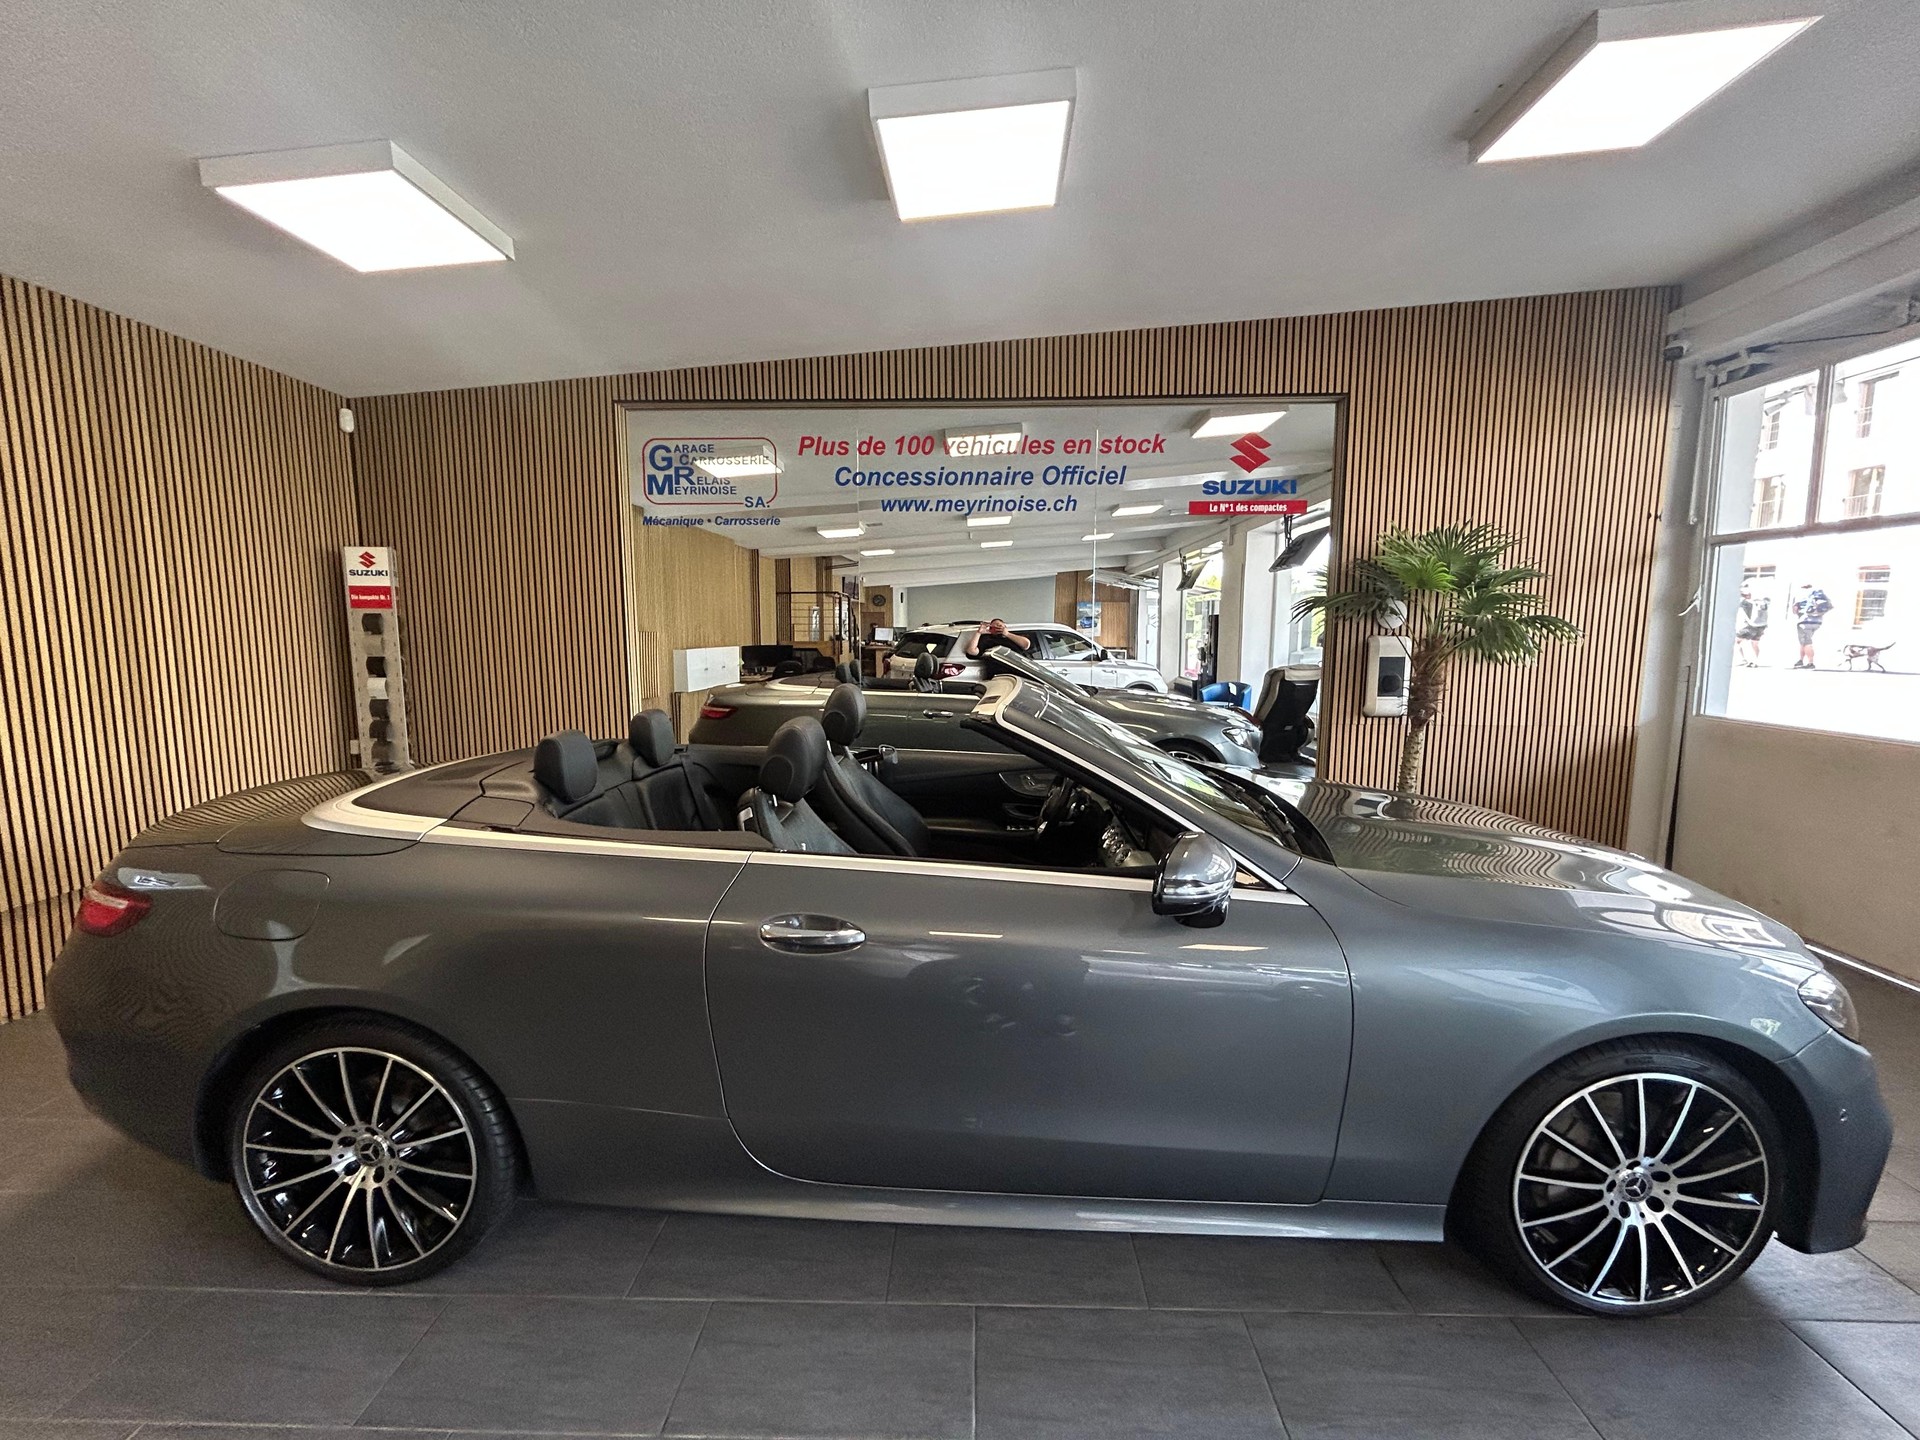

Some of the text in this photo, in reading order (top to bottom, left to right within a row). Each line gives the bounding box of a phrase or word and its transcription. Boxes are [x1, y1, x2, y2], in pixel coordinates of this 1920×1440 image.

[798, 433, 1167, 457] Plus de 100 véhicules en stock
[679, 453, 769, 466] CARROSSERIE
[835, 465, 1127, 486] Concessionnaire Officiel
[1202, 479, 1297, 495] SUZUKI
[881, 495, 1078, 516] www.meyrinoise.ch
[1209, 503, 1218, 512] Le
[1235, 503, 1249, 512] des
[1250, 504, 1287, 512] compactes
[642, 515, 781, 527] Mécanique Carrosserie
